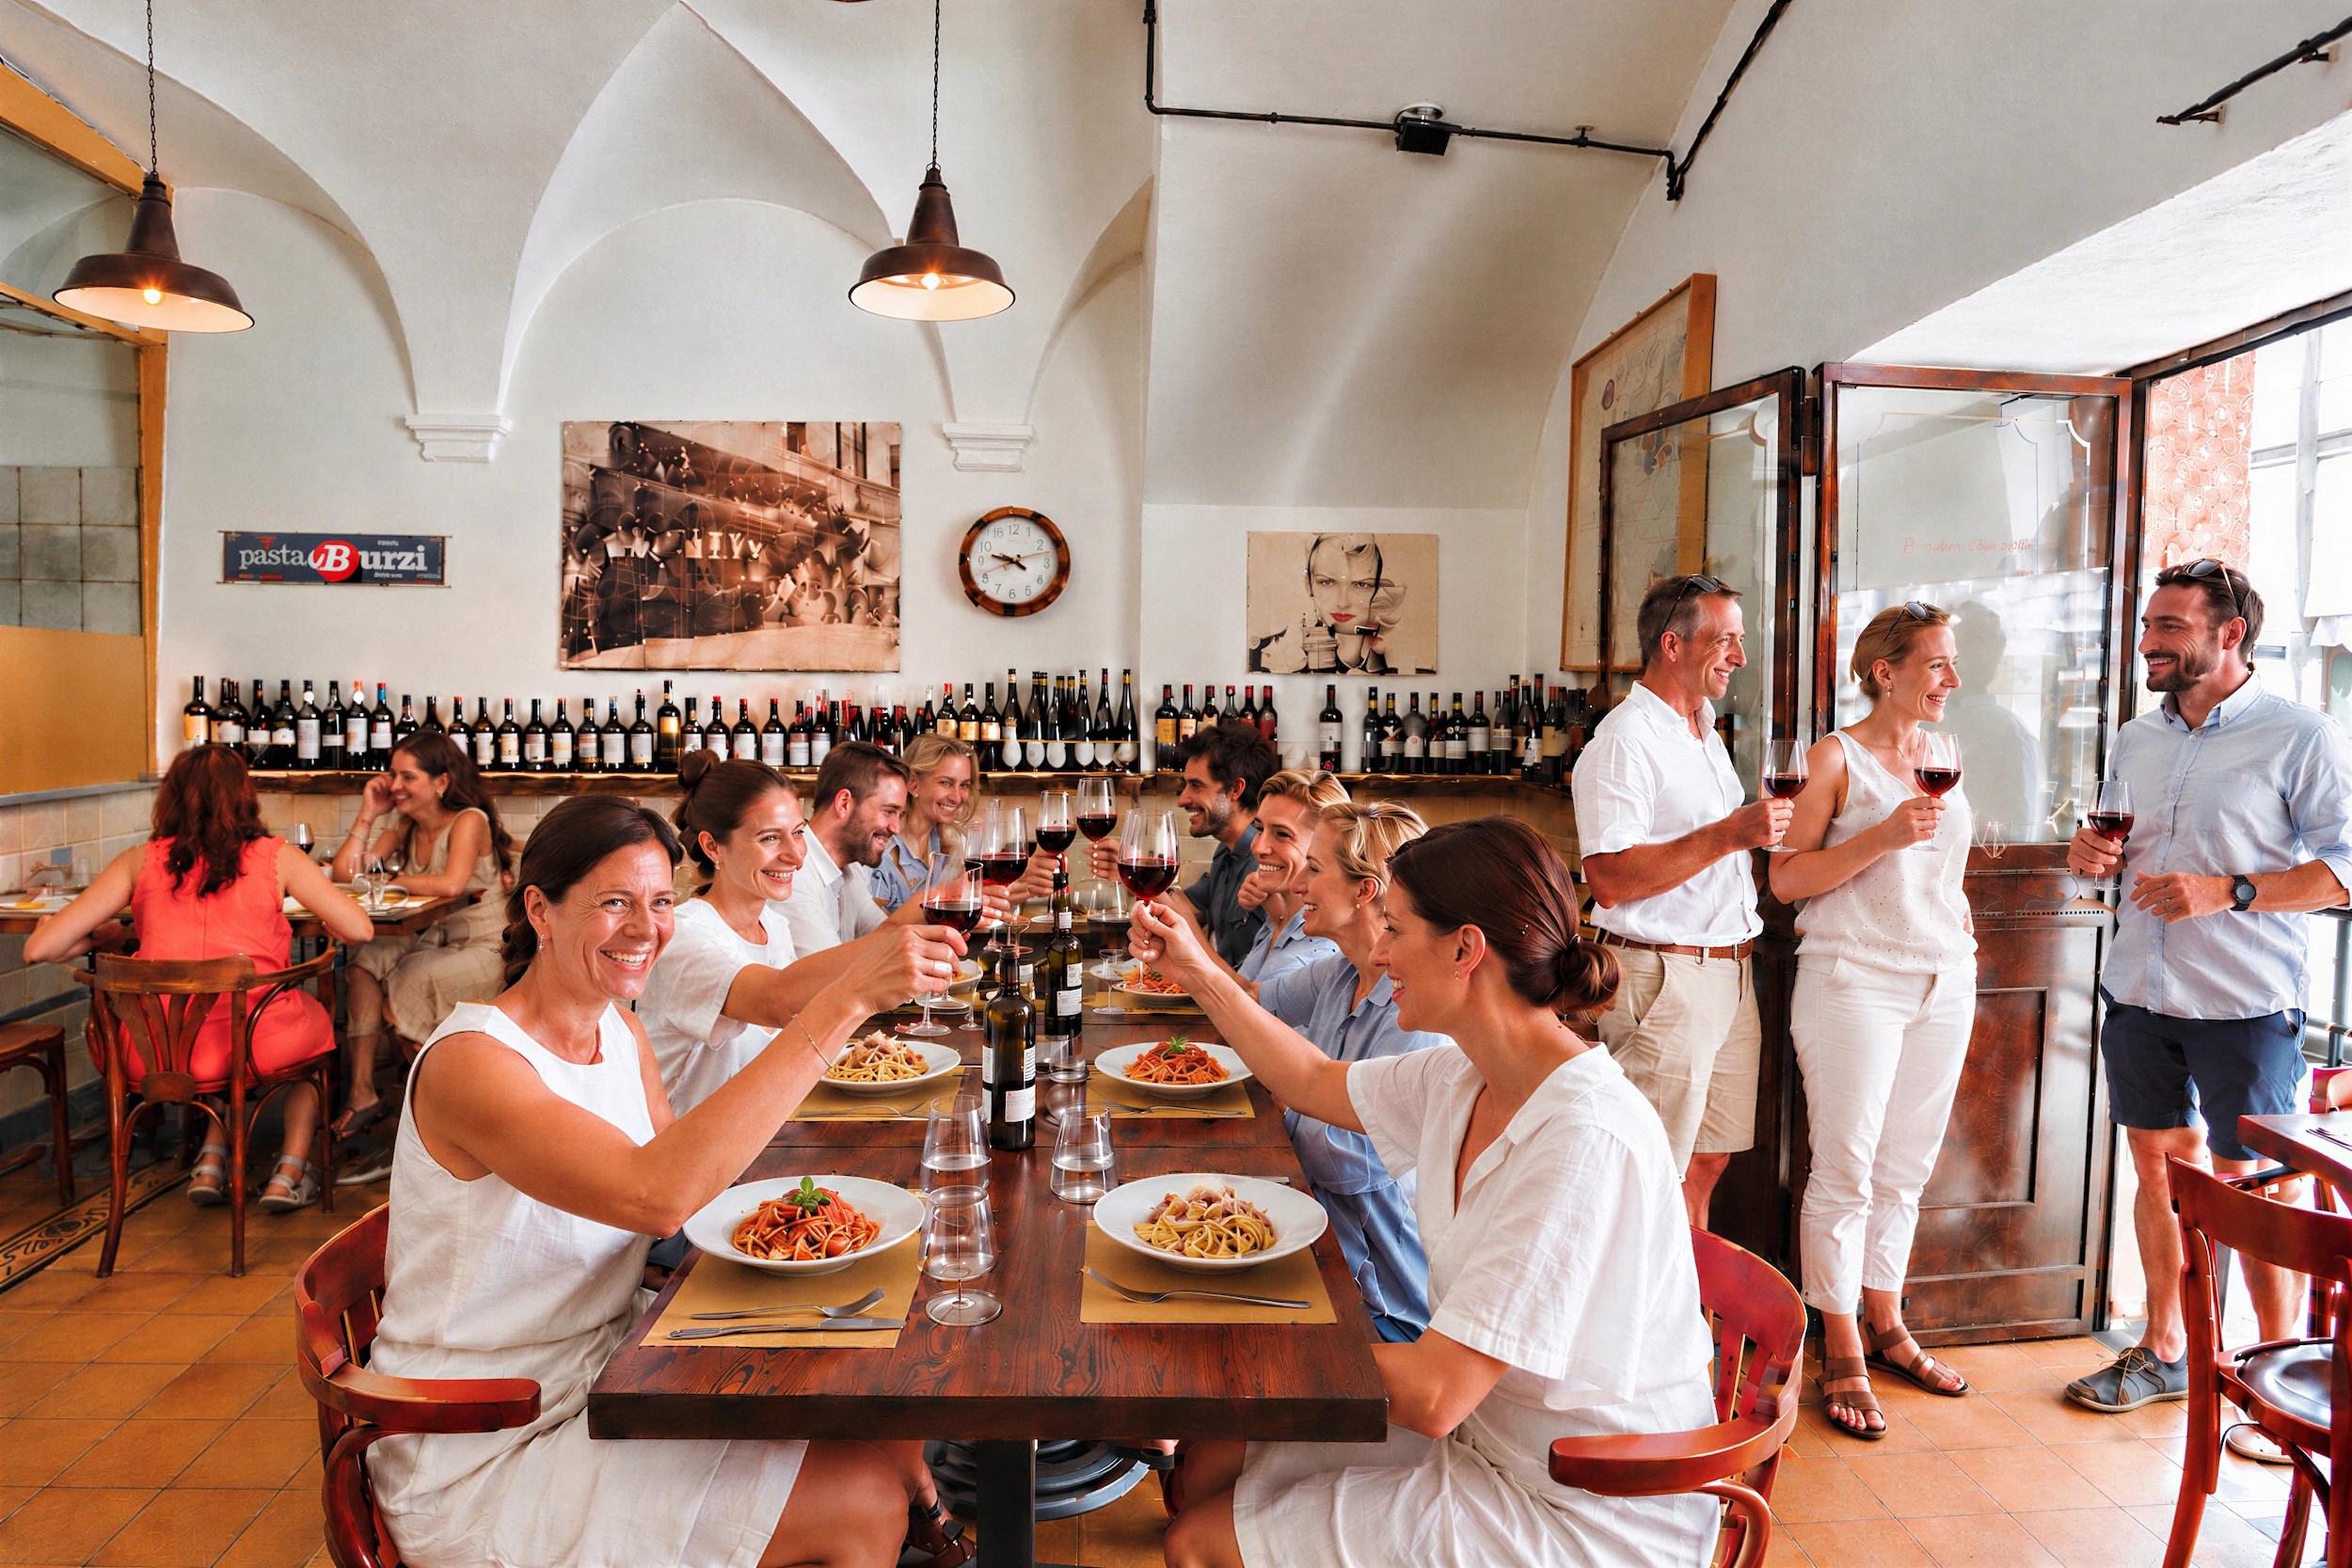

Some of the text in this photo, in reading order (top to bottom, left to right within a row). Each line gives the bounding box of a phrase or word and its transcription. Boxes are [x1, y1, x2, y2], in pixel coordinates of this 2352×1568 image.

[1009, 524, 1020, 535] 12
[1025, 527, 1031, 537] 1
[979, 541, 993, 552] 10
[1037, 539, 1044, 550] 2
[238, 544, 307, 570] pasta
[977, 556, 984, 566] 9
[1043, 558, 1051, 569] 3
[982, 574, 990, 584] 8
[994, 584, 1002, 594] 7
[1009, 589, 1016, 599] 6
